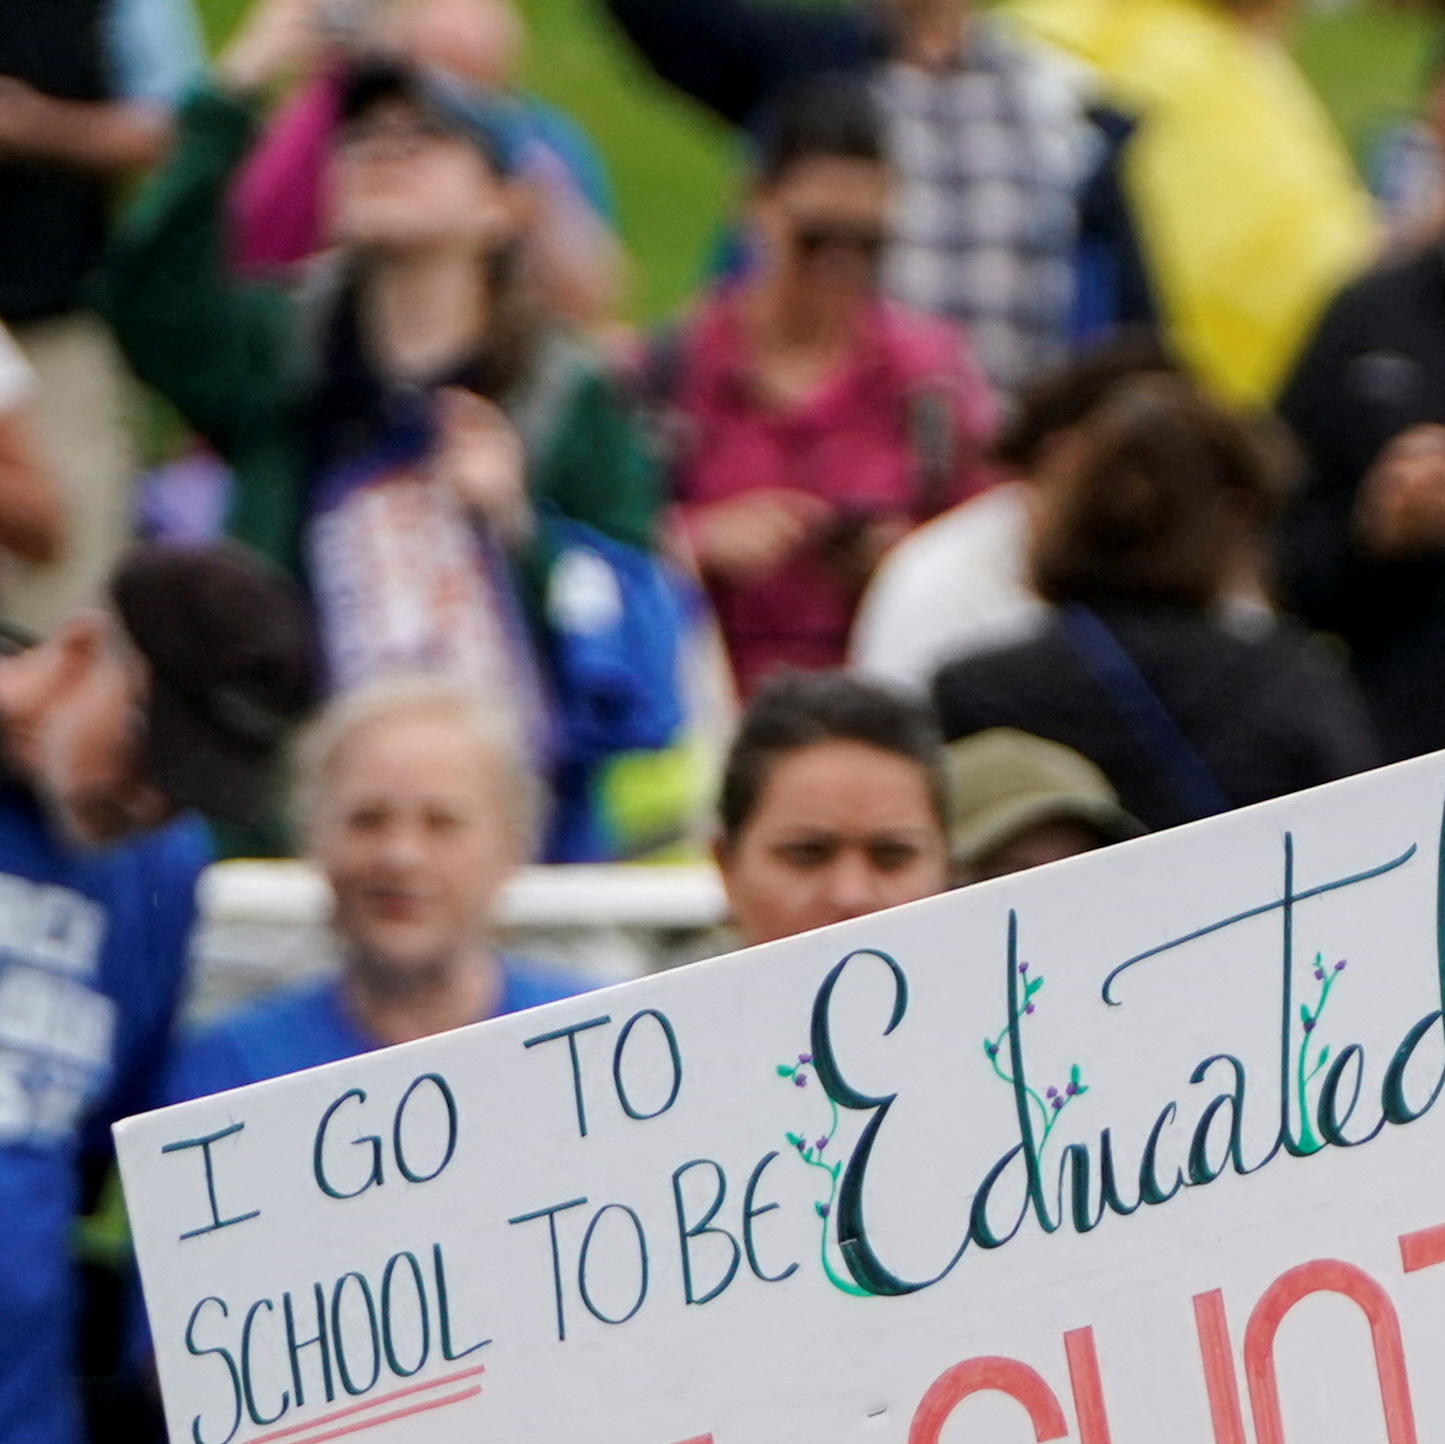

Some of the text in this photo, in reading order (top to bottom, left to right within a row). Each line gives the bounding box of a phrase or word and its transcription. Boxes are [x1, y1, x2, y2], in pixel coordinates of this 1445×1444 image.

[162, 1009, 681, 1241] I GO TO
[508, 1197, 647, 1341] TO
[672, 1151, 799, 1305] BE
